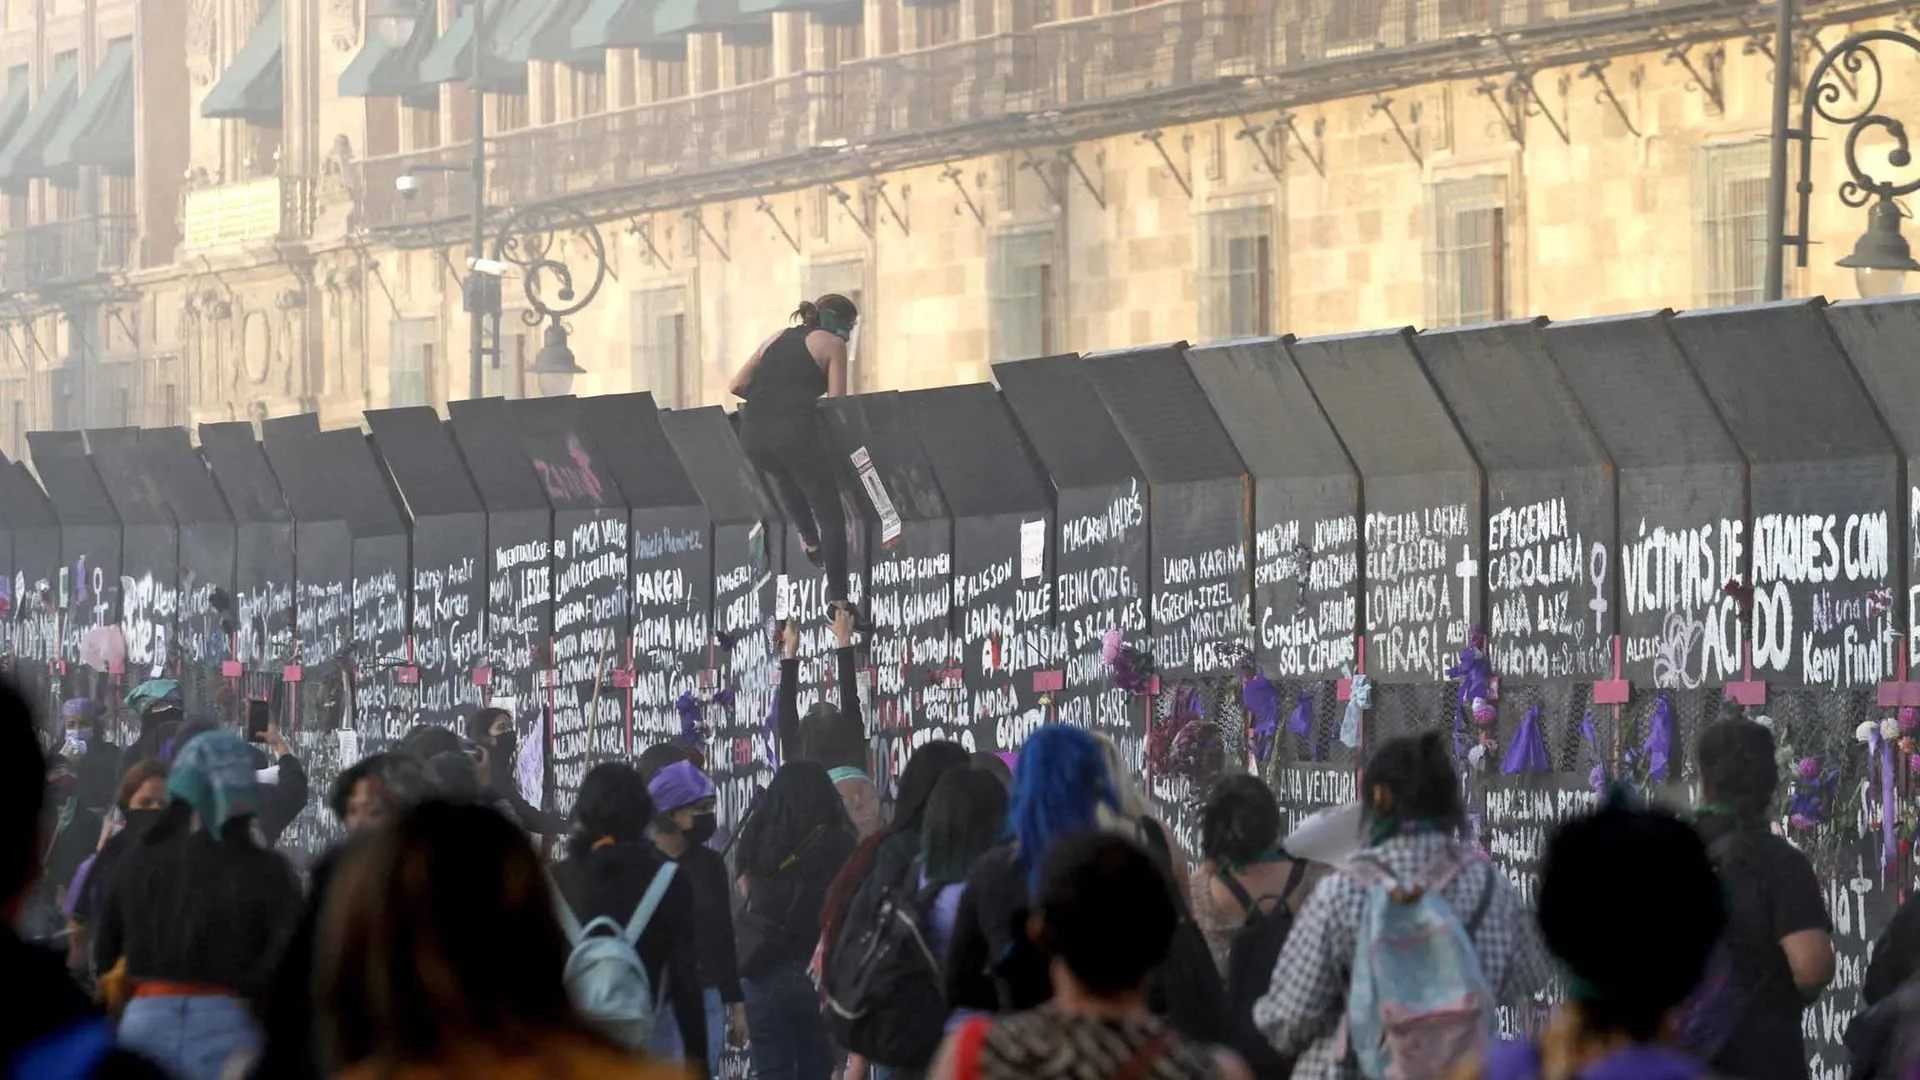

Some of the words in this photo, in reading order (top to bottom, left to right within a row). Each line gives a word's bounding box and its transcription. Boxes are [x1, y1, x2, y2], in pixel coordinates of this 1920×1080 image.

[1488, 532, 1583, 593] CAROLINA
[1719, 517, 1744, 587] DE
[1751, 513, 1840, 584] ATAQUES
[1844, 509, 1889, 581] CON
[1305, 768, 1357, 806] VENTURA
